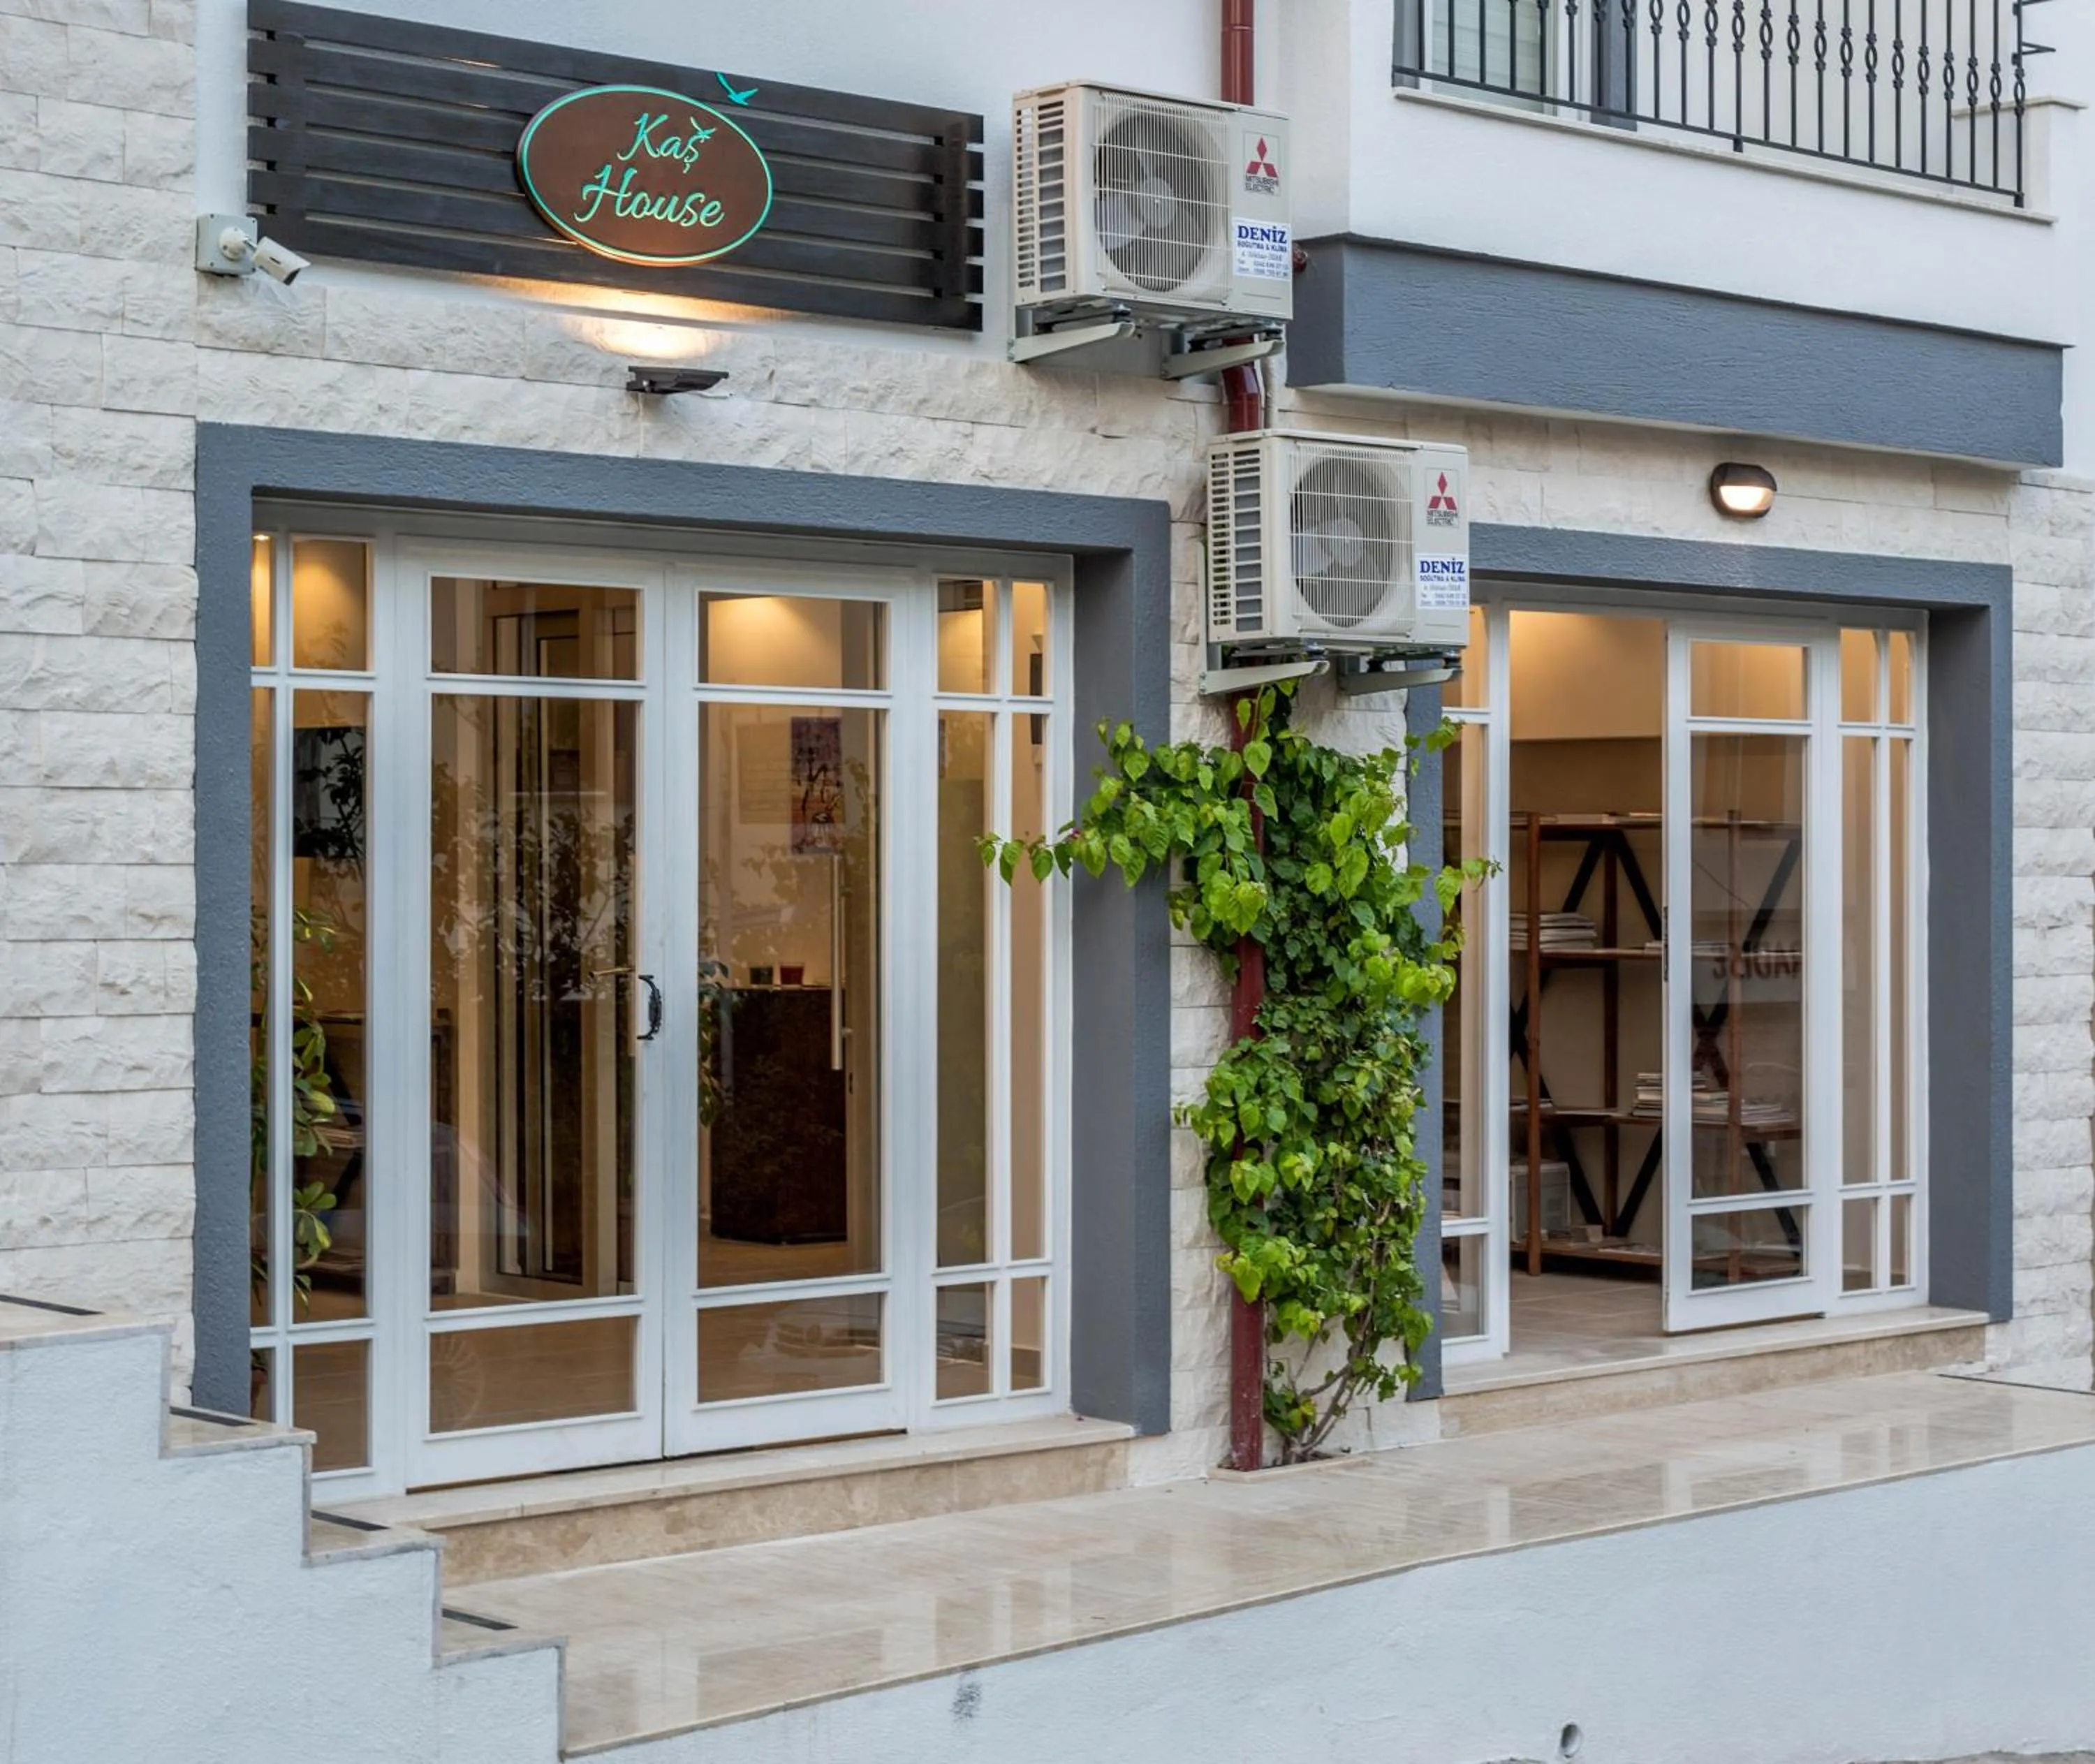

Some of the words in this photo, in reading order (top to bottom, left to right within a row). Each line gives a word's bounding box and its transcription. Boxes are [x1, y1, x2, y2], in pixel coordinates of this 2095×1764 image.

[617, 112, 708, 174] Kaş
[1245, 175, 1279, 187] MITSUBISHI
[1245, 182, 1274, 195] ELECTRIC
[573, 163, 725, 228] House
[1237, 224, 1287, 244] DENİZ
[1420, 557, 1464, 573] DENİZ
